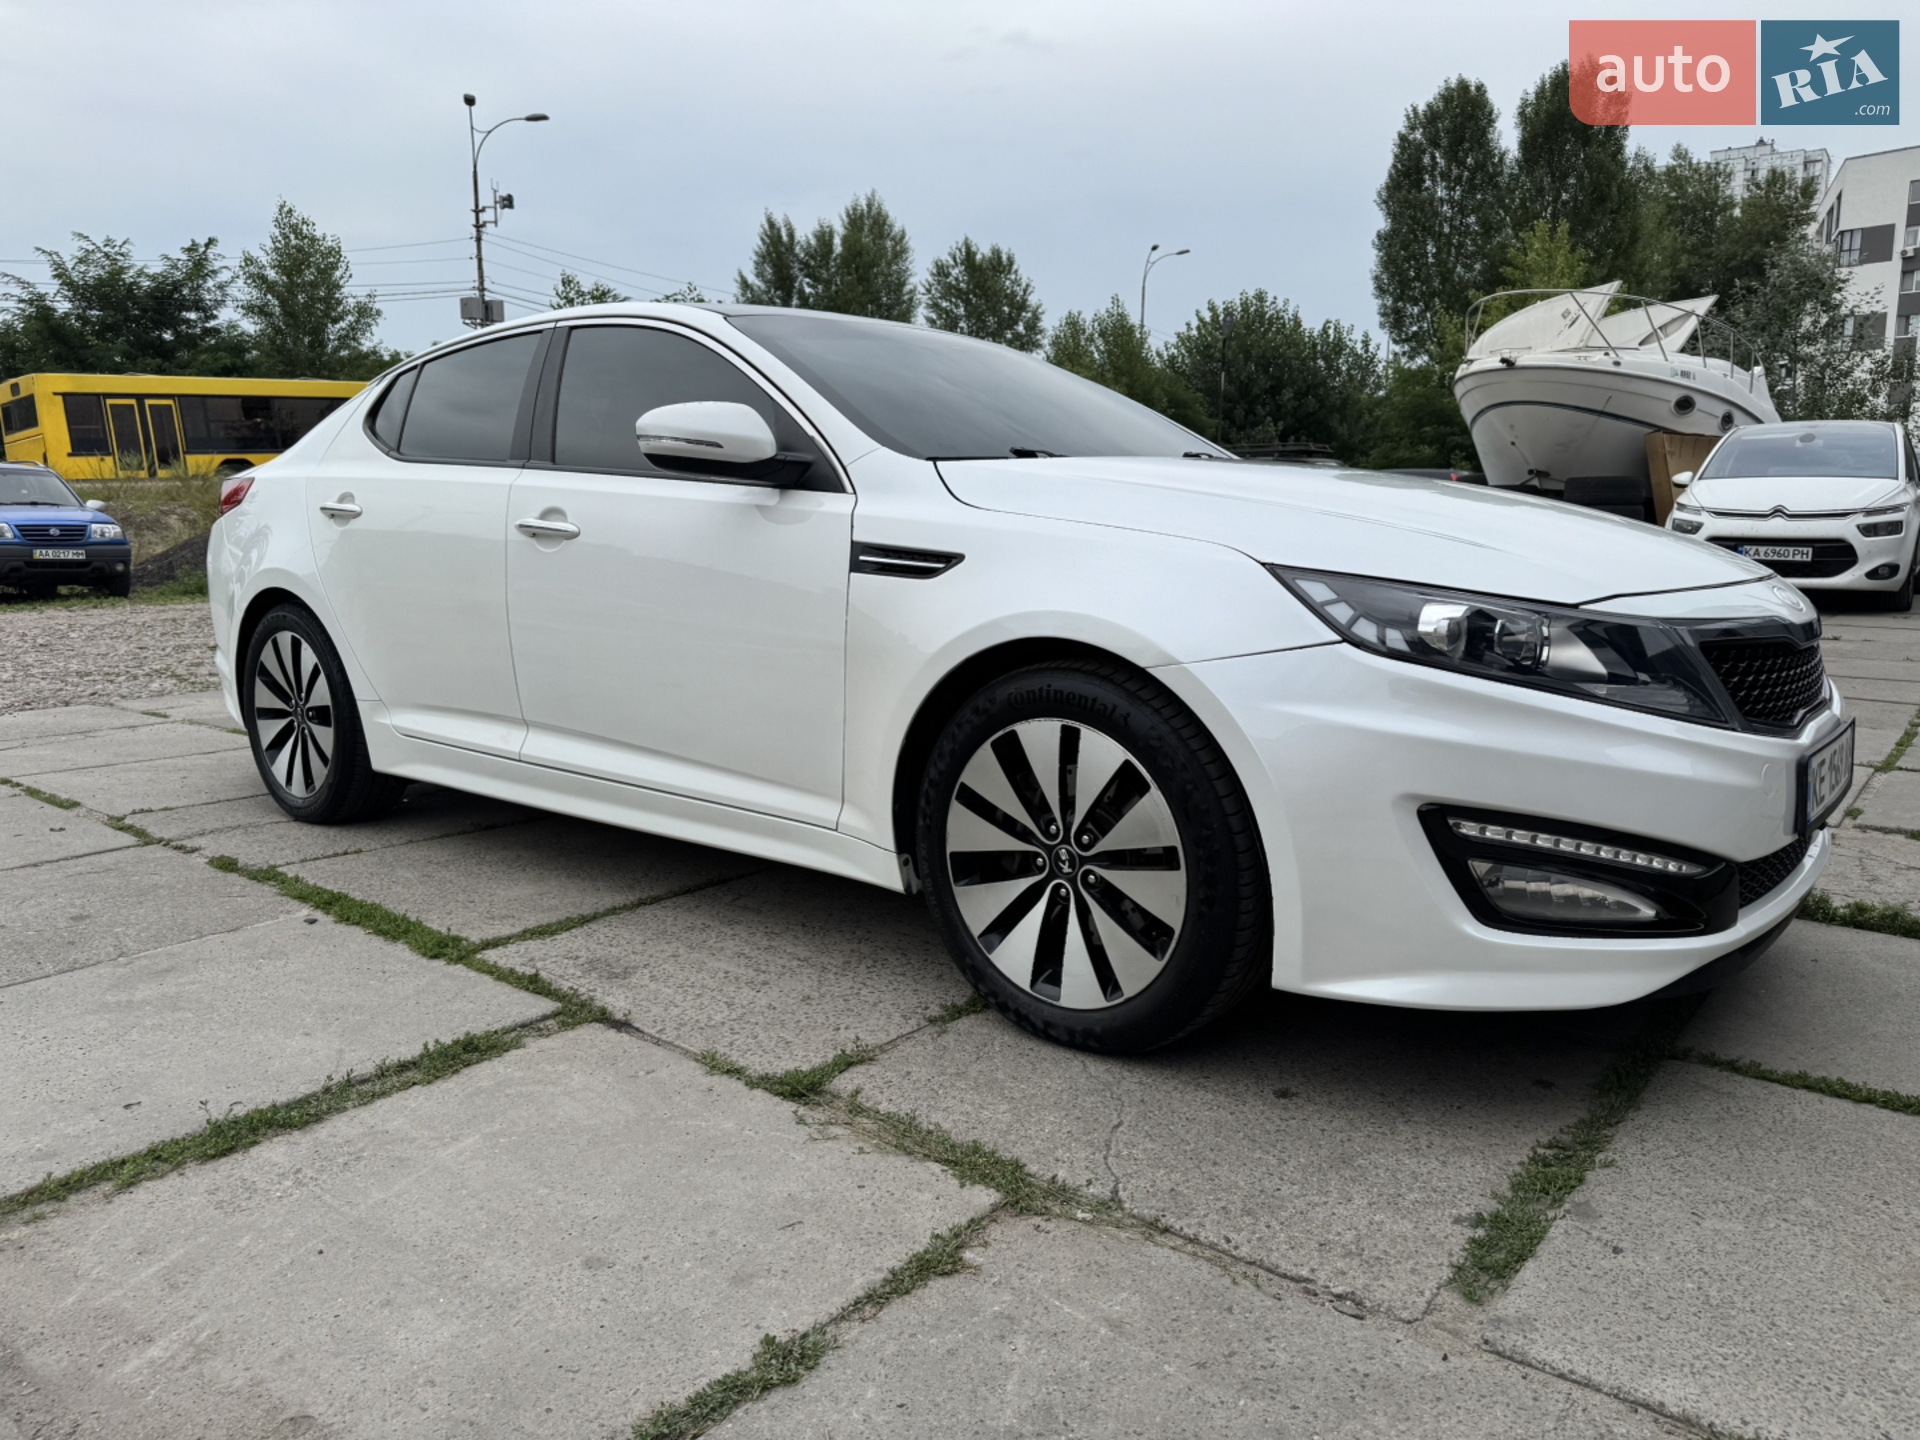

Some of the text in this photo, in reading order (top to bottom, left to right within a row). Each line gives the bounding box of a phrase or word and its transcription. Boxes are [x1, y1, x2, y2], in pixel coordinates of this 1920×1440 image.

[1744, 547, 1809, 559] KA 6960 PH
[1007, 683, 1118, 722] Continental
[1812, 758, 1826, 812] KE
